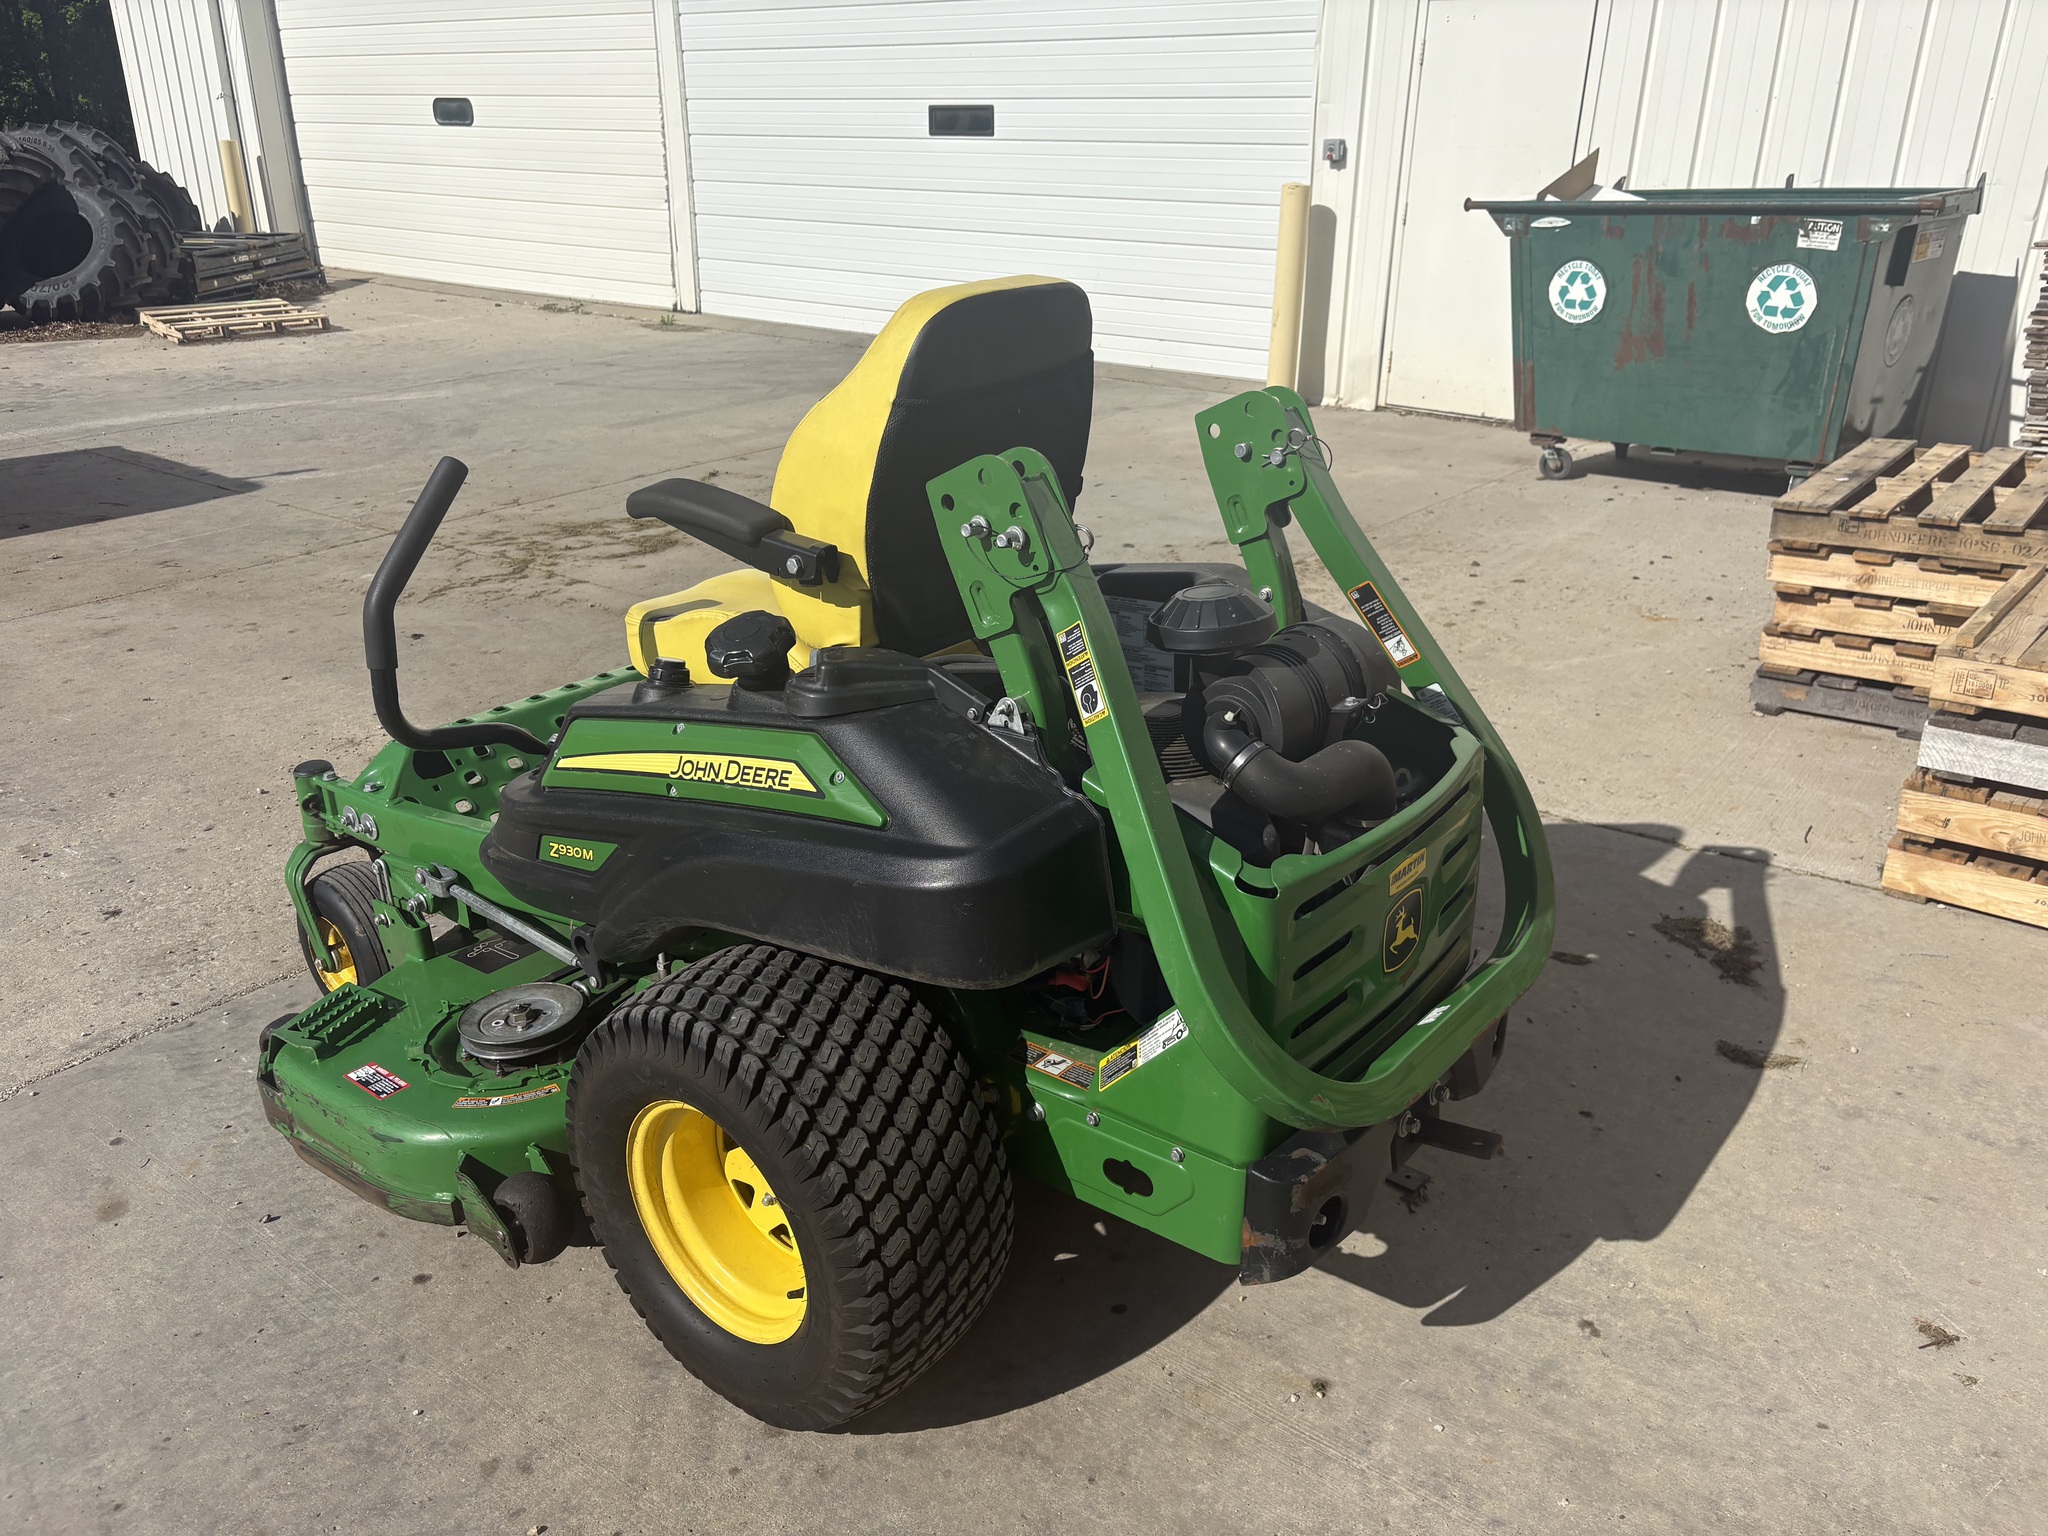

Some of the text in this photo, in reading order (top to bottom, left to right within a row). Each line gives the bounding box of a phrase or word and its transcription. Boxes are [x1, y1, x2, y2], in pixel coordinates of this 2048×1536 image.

[1557, 262, 1601, 280] RECYCLE TODAY
[1757, 265, 1812, 287] RECYCLE TODAY
[1554, 302, 1599, 321] FOR TOMORROW
[1751, 308, 1806, 330] FOR TOMORROW
[1902, 619, 1935, 633] JOHN
[669, 755, 793, 788] JOHN DEERE
[2017, 831, 2047, 845] JOHN
[549, 842, 594, 861] Z930M
